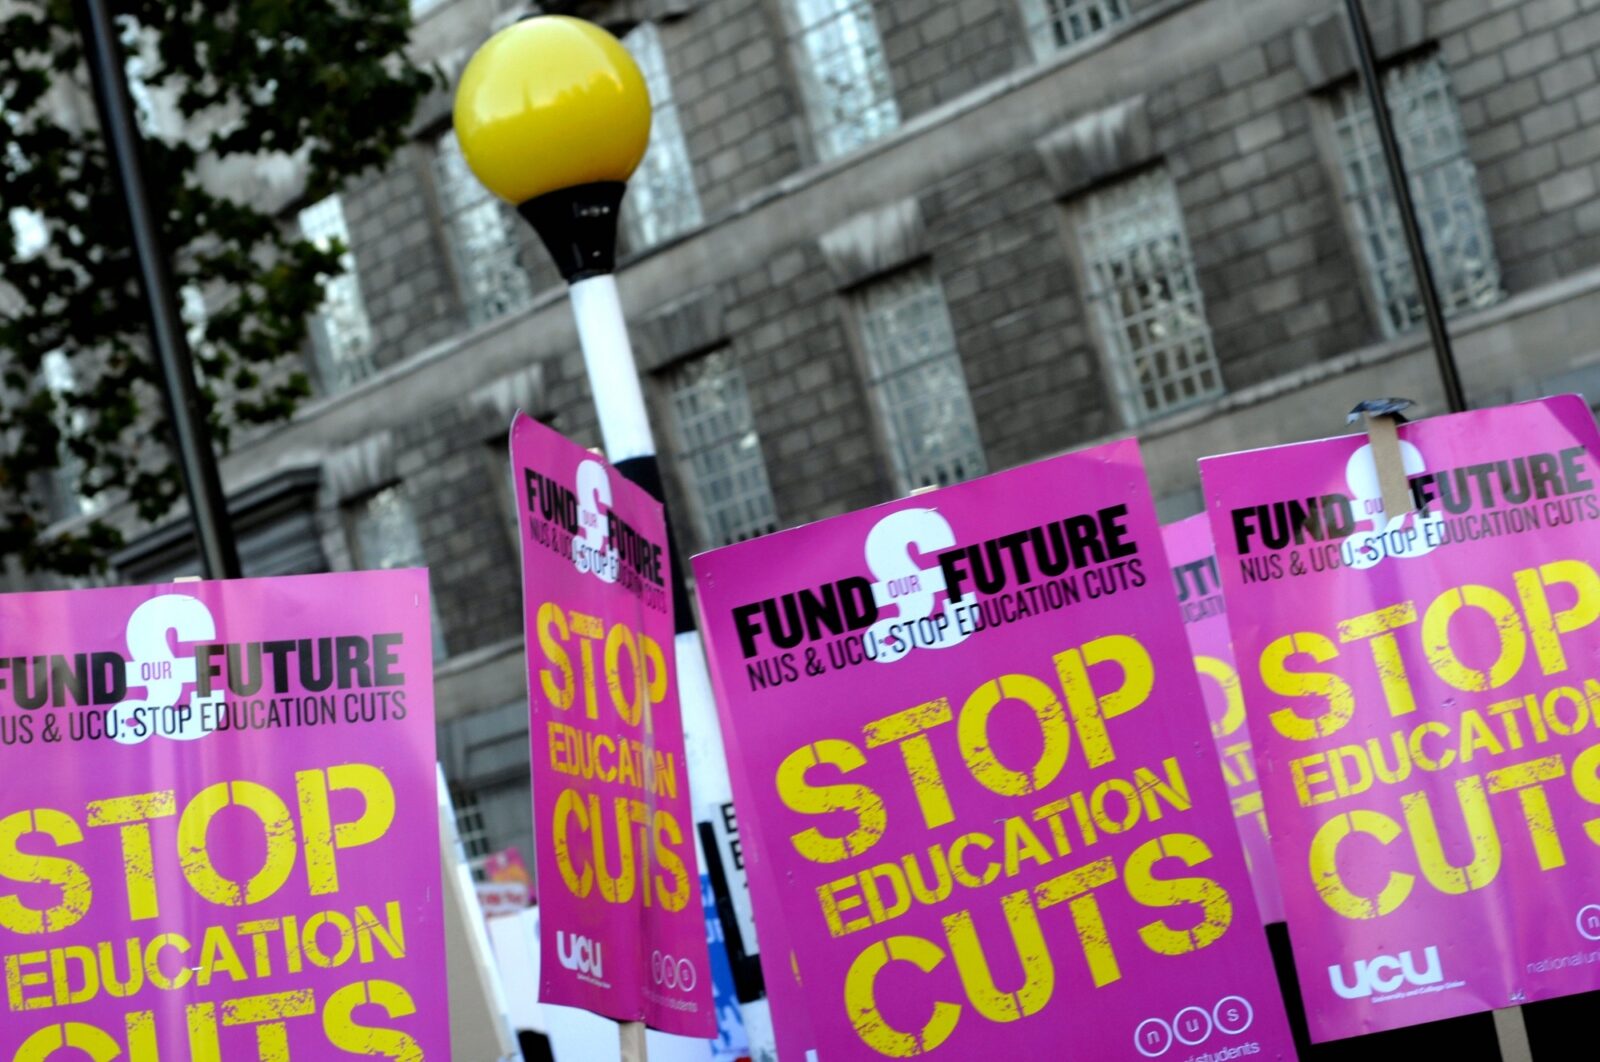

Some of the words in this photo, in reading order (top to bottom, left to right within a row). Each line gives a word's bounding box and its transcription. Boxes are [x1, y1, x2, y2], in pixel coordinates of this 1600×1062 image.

[524, 467, 579, 535] FUND
[606, 508, 665, 588] FUTURE
[1231, 492, 1355, 555] FUND
[1409, 445, 1596, 517] FUTURE
[1240, 552, 1285, 584] NUS
[1290, 549, 1307, 576] &
[1364, 526, 1418, 562] STOP
[1424, 504, 1540, 549] EDUCATION
[1545, 493, 1600, 529] CUTS
[1363, 497, 1385, 516] OU
[731, 576, 879, 658] FUND
[937, 504, 1138, 603] FUTURE
[747, 649, 799, 691] NUS
[805, 653, 825, 677] &
[891, 612, 950, 654] STOP
[957, 571, 1081, 636] EDUCATION
[1083, 558, 1147, 597] CUTS
[887, 574, 921, 598] OUR
[141, 661, 172, 681] OUR
[195, 633, 405, 698] FUTURE
[536, 602, 668, 727] STOP
[1259, 560, 1600, 741] STOP
[42, 713, 62, 742] &
[133, 702, 192, 738] STOP
[201, 695, 336, 731] EDUCATION
[344, 692, 407, 722] CUTS
[775, 634, 1155, 863] STOP
[0, 763, 396, 935] STOP
[553, 788, 691, 913] CUTS
[816, 757, 1192, 937] EDUCATION
[5, 901, 405, 1011] EDUCATION
[844, 833, 1232, 1058] CUTS
